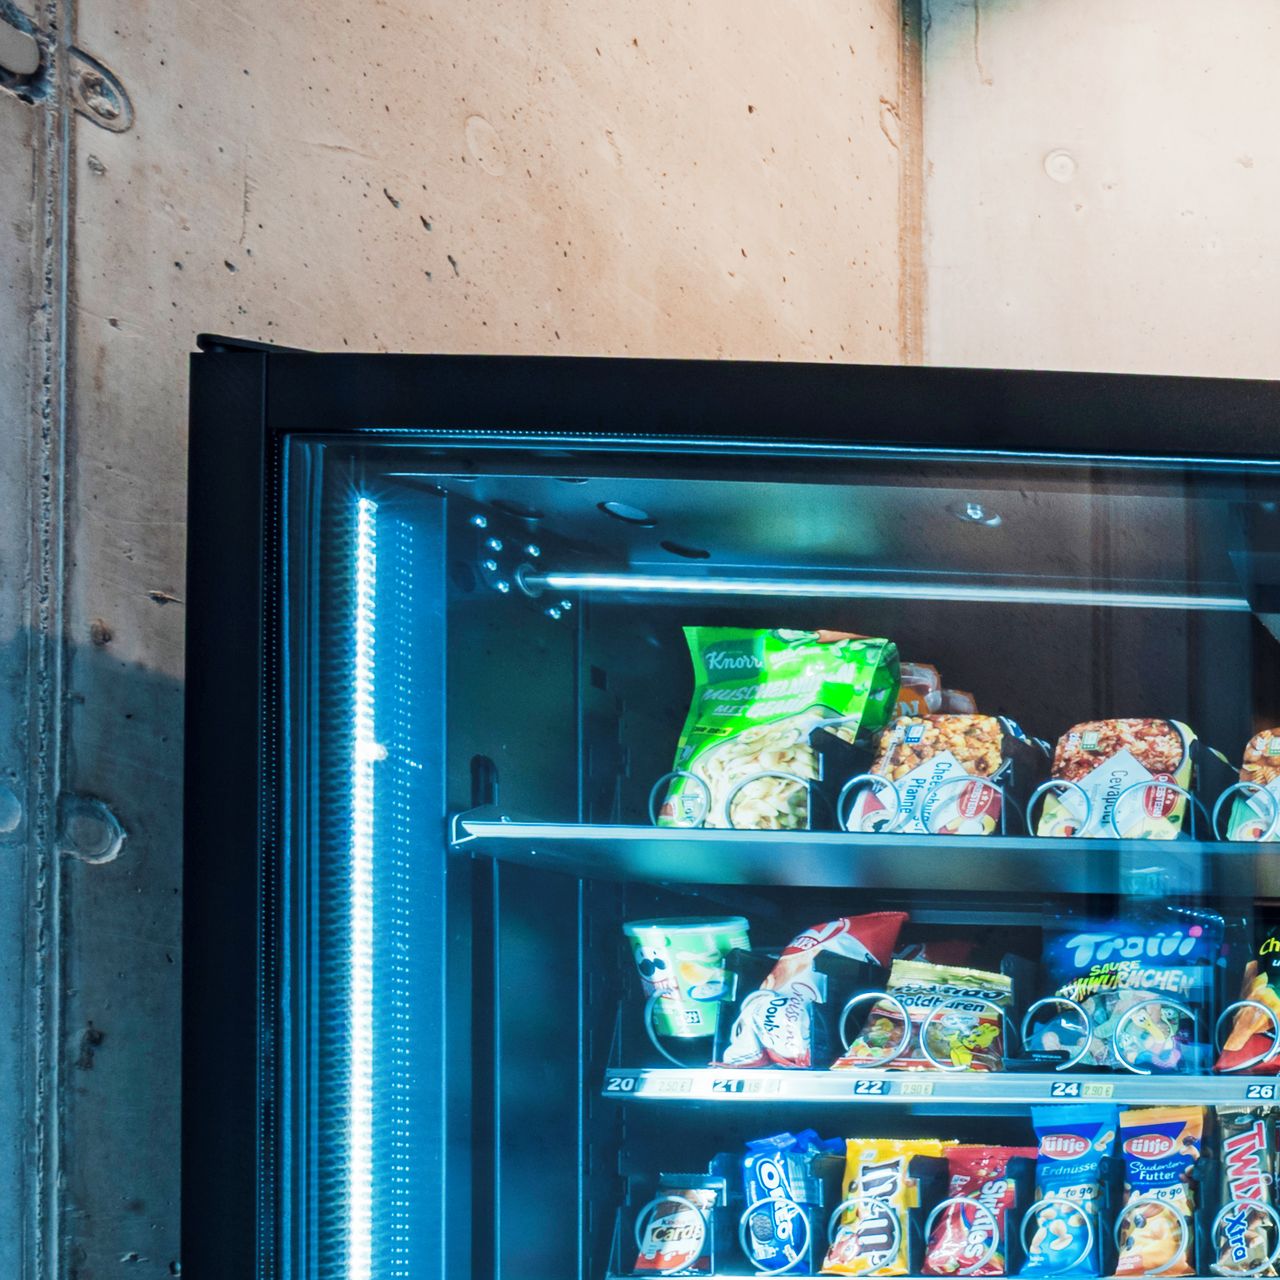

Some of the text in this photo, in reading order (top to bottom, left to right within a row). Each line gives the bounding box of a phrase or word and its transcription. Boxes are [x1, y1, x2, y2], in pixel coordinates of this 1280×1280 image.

[705, 651, 764, 671] Knorr
[1089, 960, 1141, 976] SAURE
[607, 1078, 635, 1091] 20
[856, 1080, 883, 1095] 22
[1051, 1082, 1079, 1097] 24
[1248, 1083, 1274, 1098] 26
[1045, 1138, 1085, 1157] ültje
[1132, 1138, 1169, 1157] ültje
[1139, 1170, 1176, 1182] Futter
[1064, 1187, 1093, 1198] to go
[1154, 1188, 1182, 1200] to go
